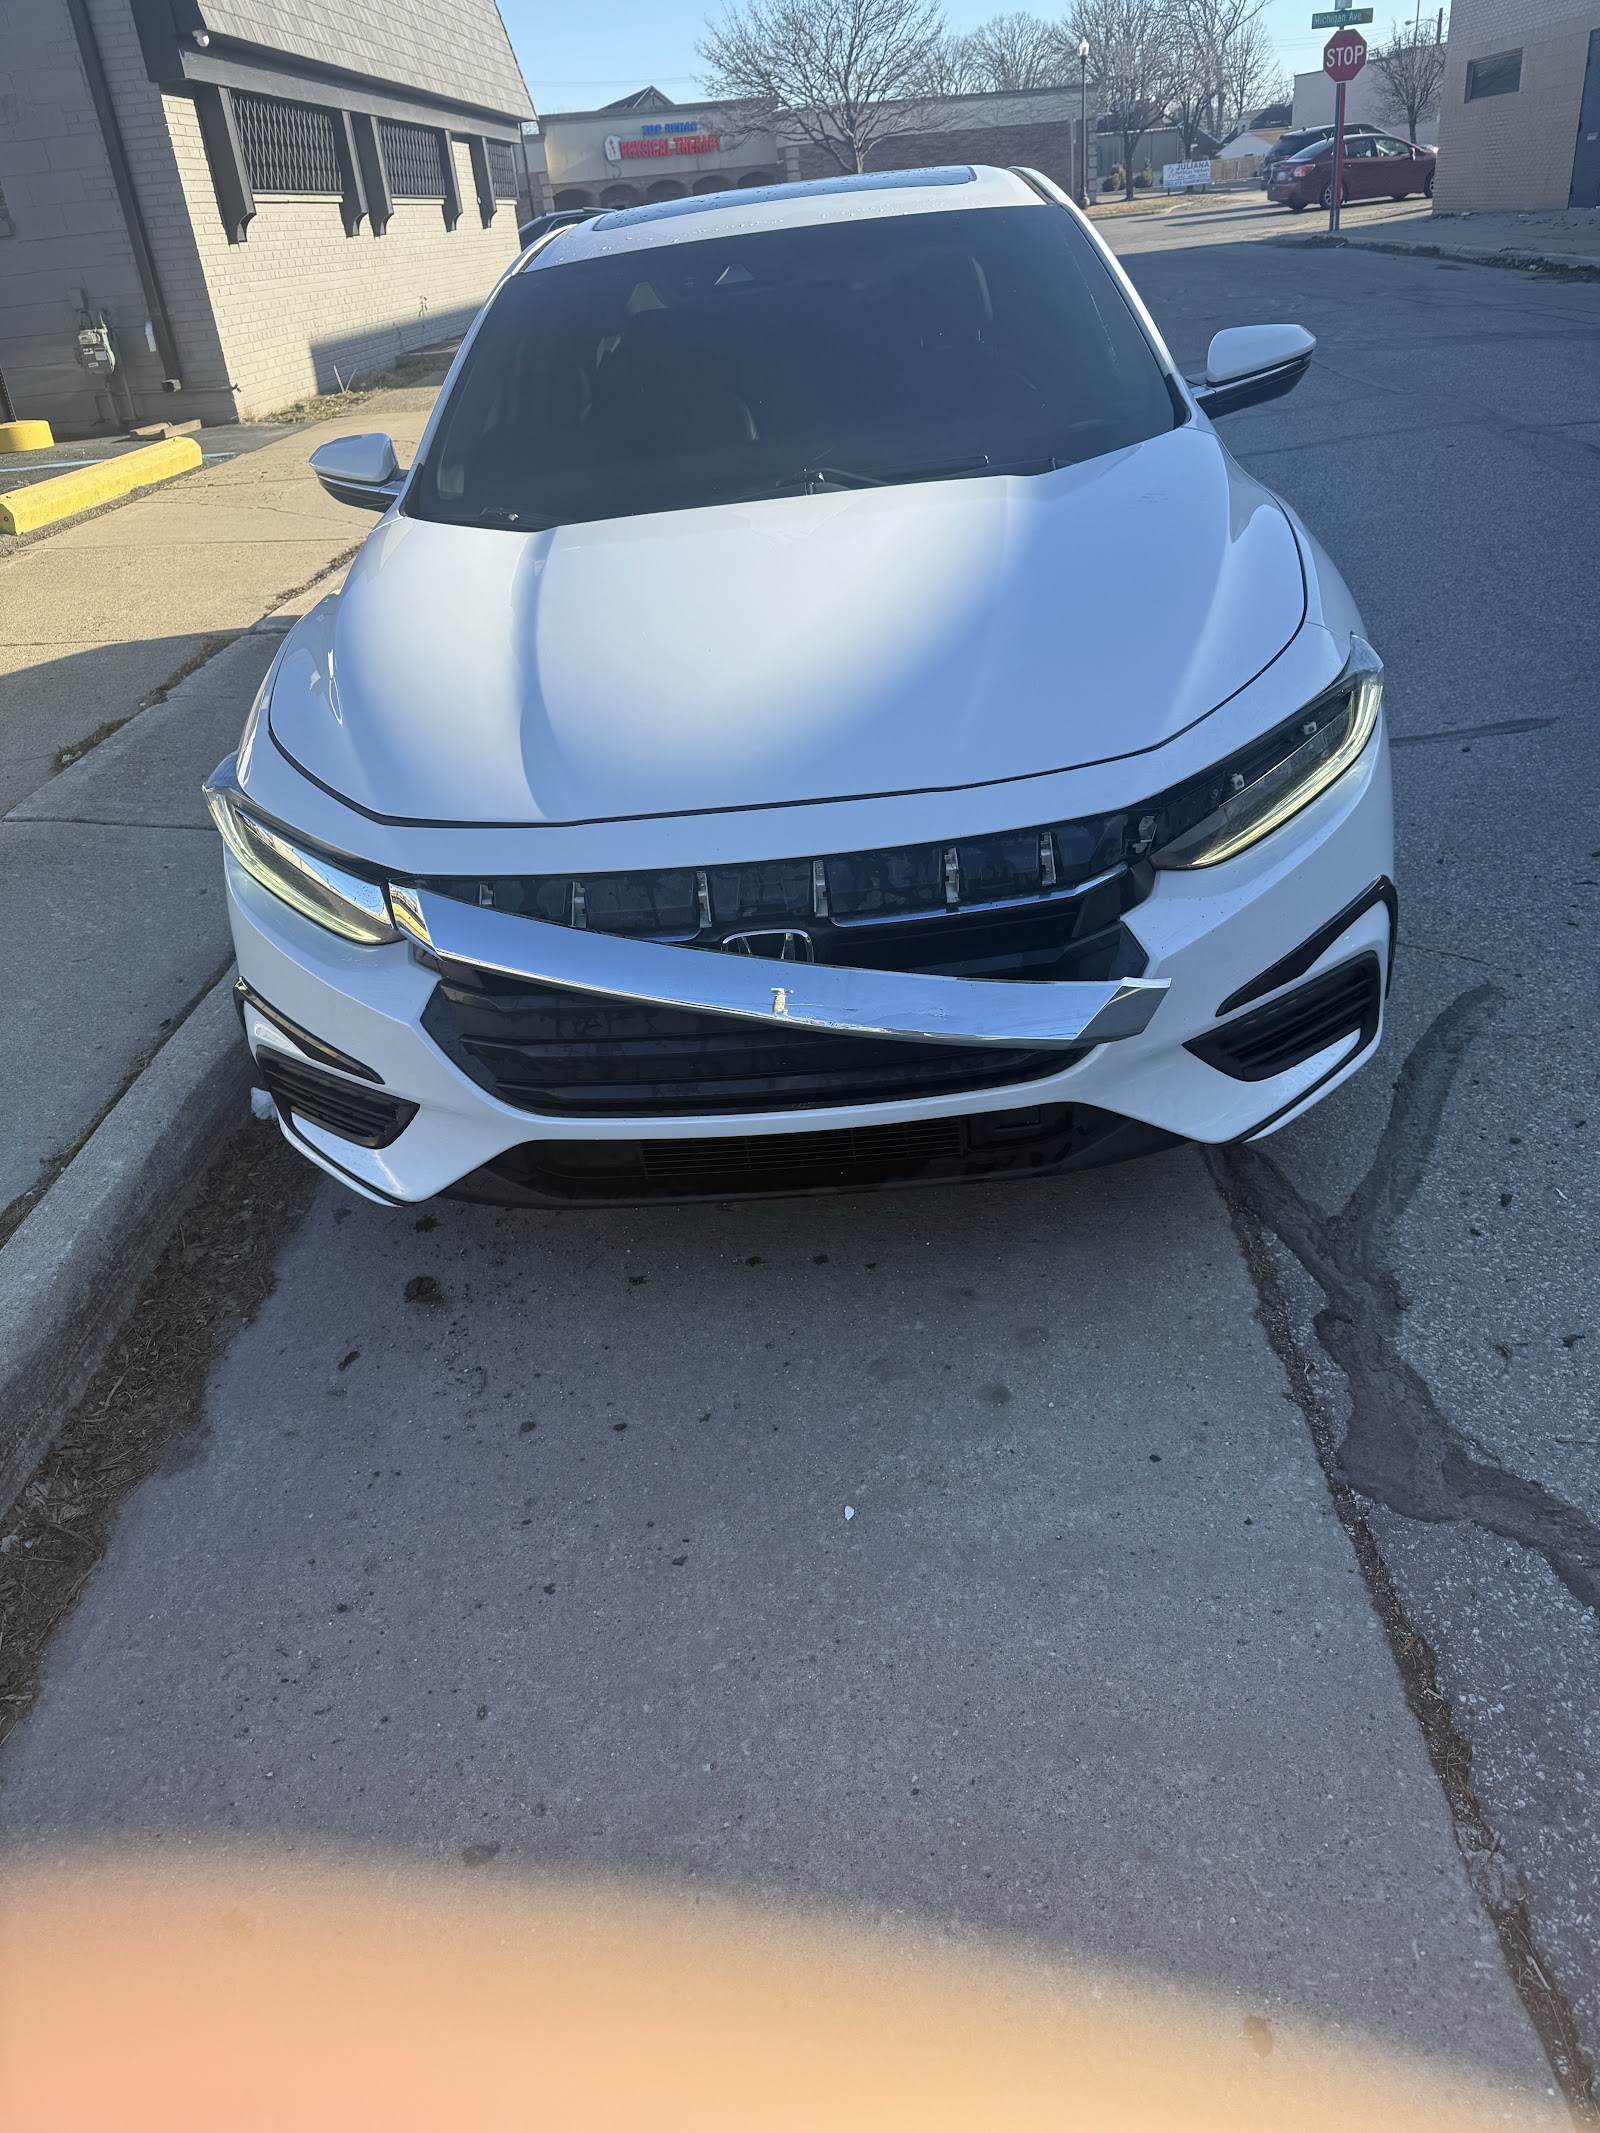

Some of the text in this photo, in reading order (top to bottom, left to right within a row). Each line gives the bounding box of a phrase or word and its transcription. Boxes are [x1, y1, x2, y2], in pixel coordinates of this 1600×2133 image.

[1314, 11, 1362, 25] Michigan Ave
[1326, 45, 1364, 67] STOP
[620, 135, 721, 159] PHYSICAL THERAPY
[1176, 161, 1210, 171] JULIANA
